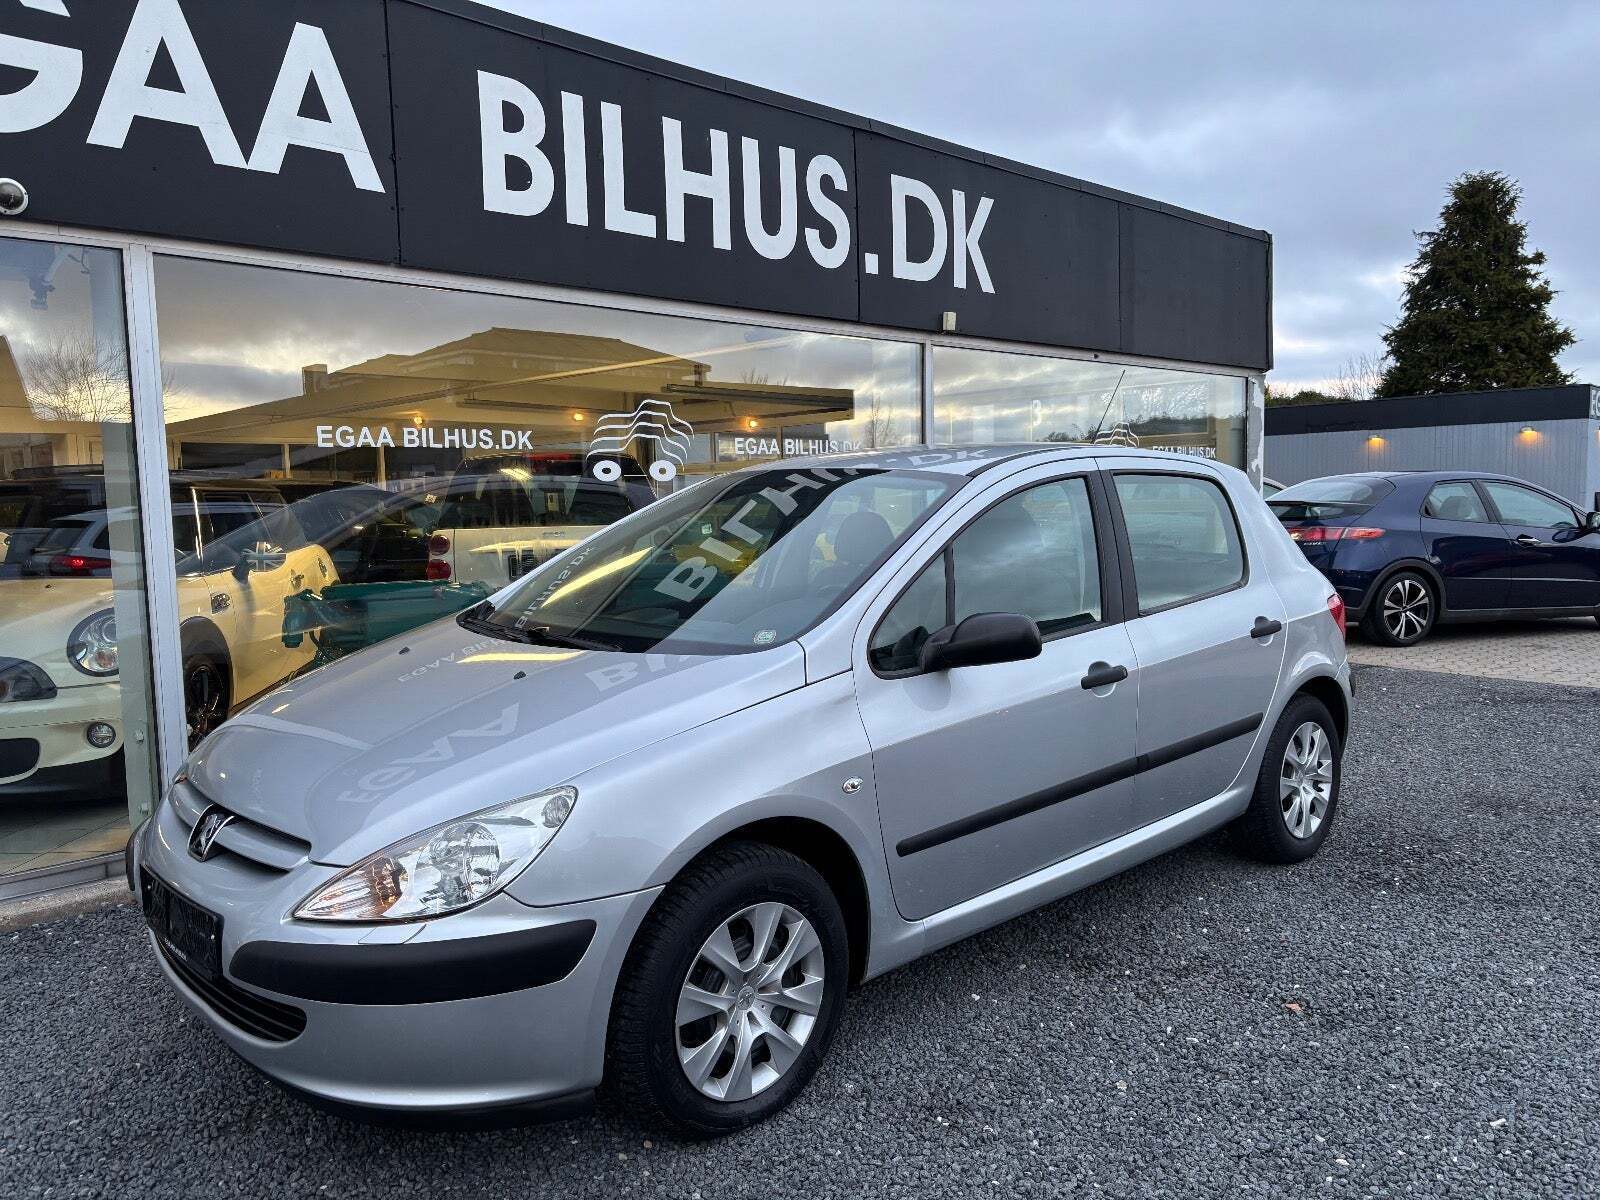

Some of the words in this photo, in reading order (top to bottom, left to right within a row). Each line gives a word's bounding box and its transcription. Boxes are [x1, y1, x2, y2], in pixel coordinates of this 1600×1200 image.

[477, 69, 996, 294] BILHUS.DK
[316, 425, 395, 448] EGAA
[403, 427, 533, 449] BILHUS.DK
[734, 437, 780, 455] EGAA
[784, 438, 862, 455] BILHUSDK
